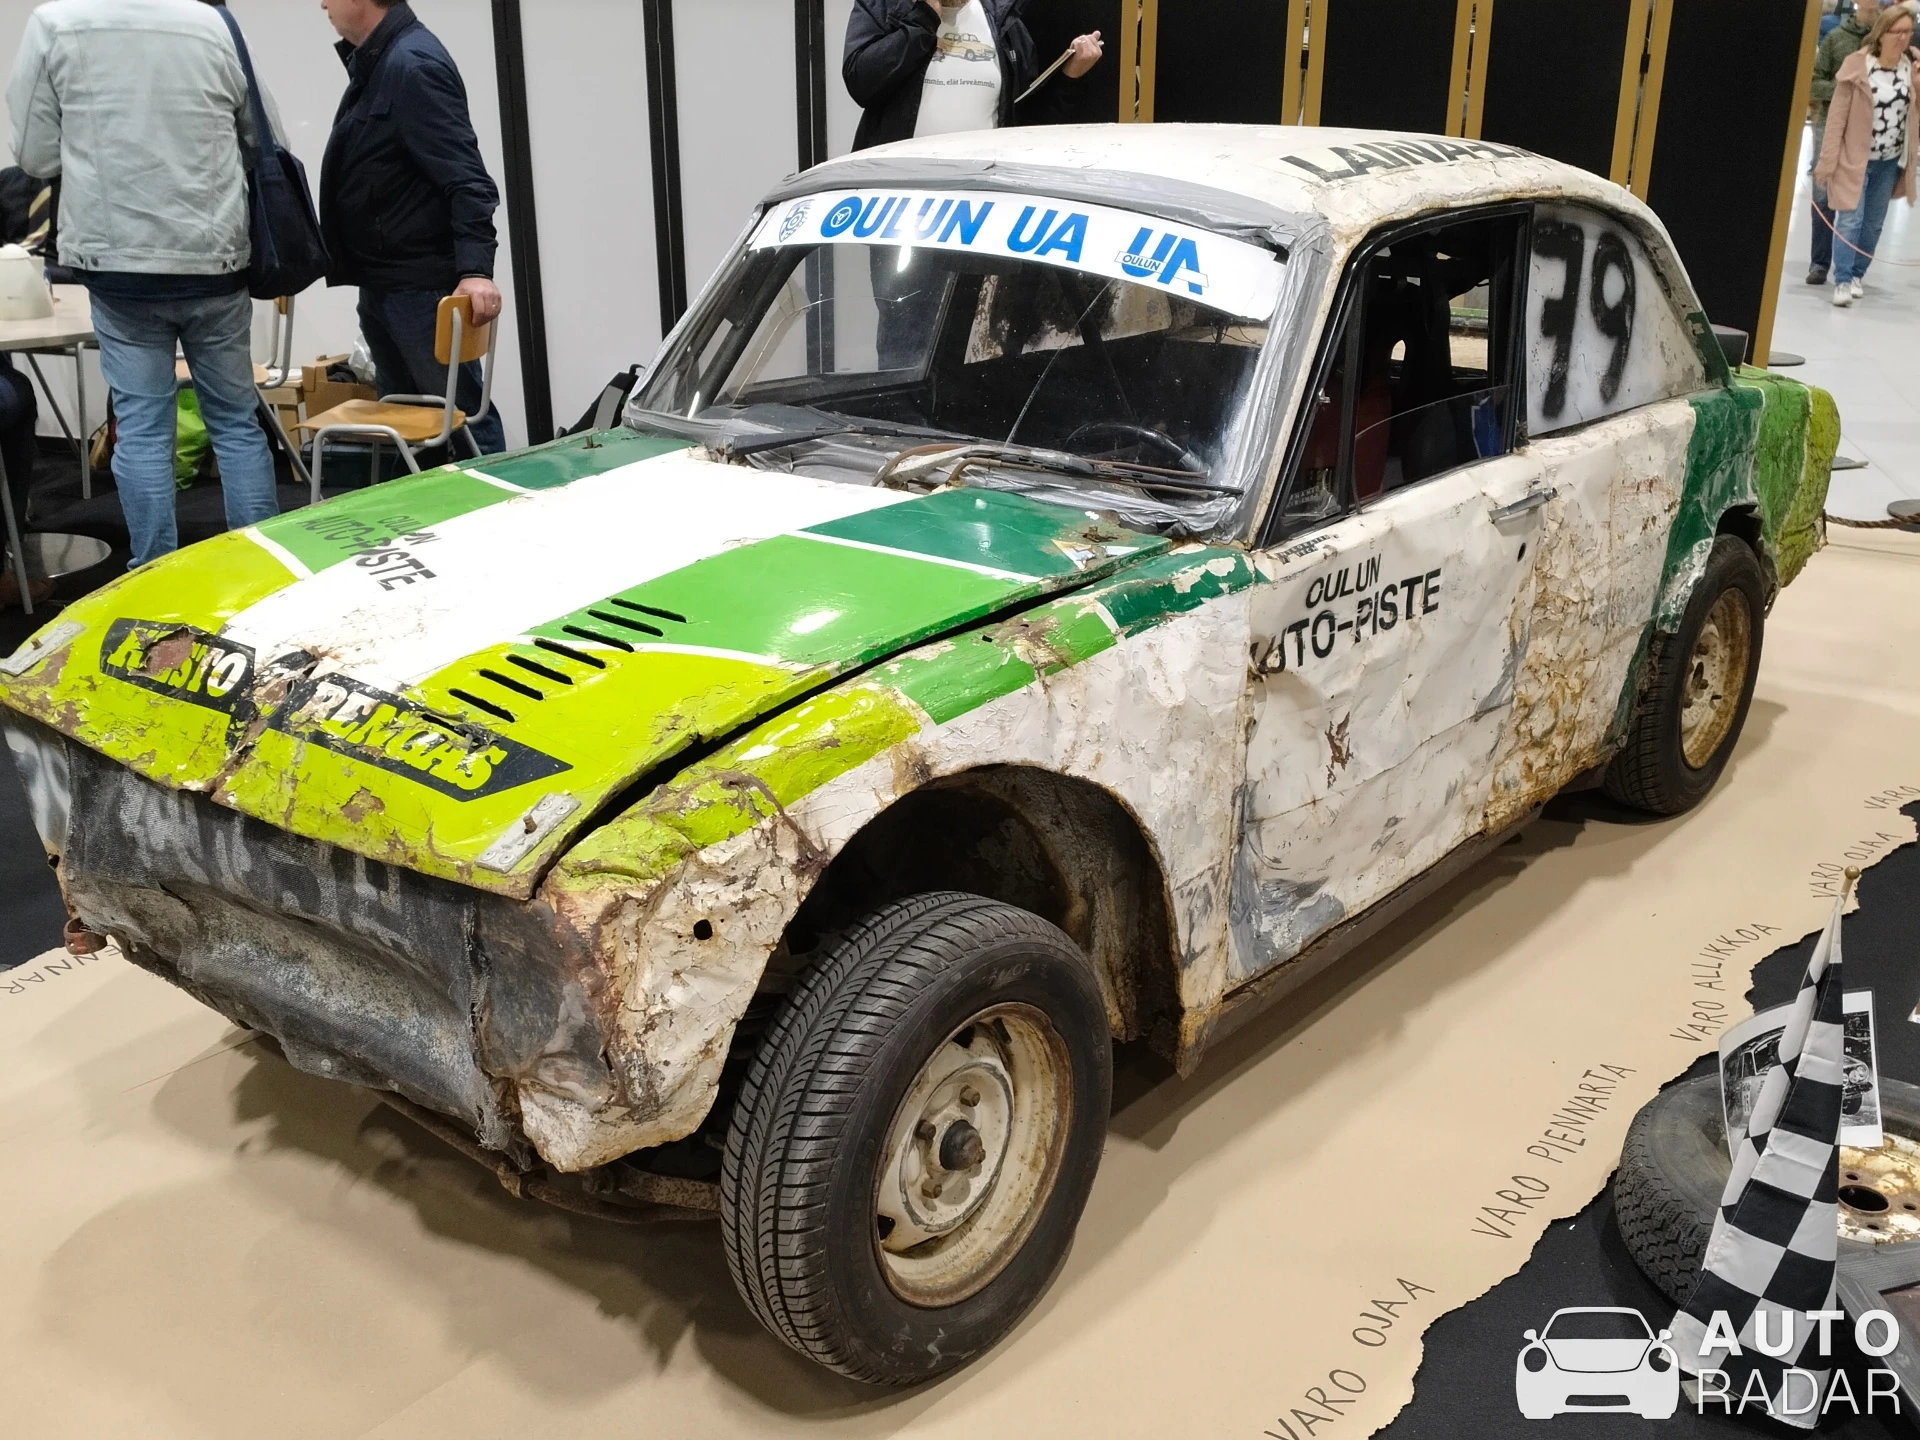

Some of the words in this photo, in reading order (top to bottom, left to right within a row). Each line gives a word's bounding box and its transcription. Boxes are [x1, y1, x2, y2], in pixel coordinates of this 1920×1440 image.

[923, 78, 946, 86] mmin,
[820, 196, 995, 246] OULUN
[1006, 206, 1090, 263] UA
[1122, 254, 1162, 272] OULUN
[1532, 219, 1636, 419] 79
[1304, 553, 1382, 609] OULUN
[1863, 785, 1920, 810] VARO
[1808, 862, 1844, 898] VARO
[1843, 831, 1903, 861] OJAA
[1690, 923, 1783, 992] ALLIKKOA
[1669, 1000, 1729, 1042] VARO
[1470, 1175, 1551, 1239] VARO
[1525, 1062, 1638, 1164] PIENNARTA
[1263, 1368, 1367, 1440] VARO
[1351, 1277, 1436, 1347] OJAA
